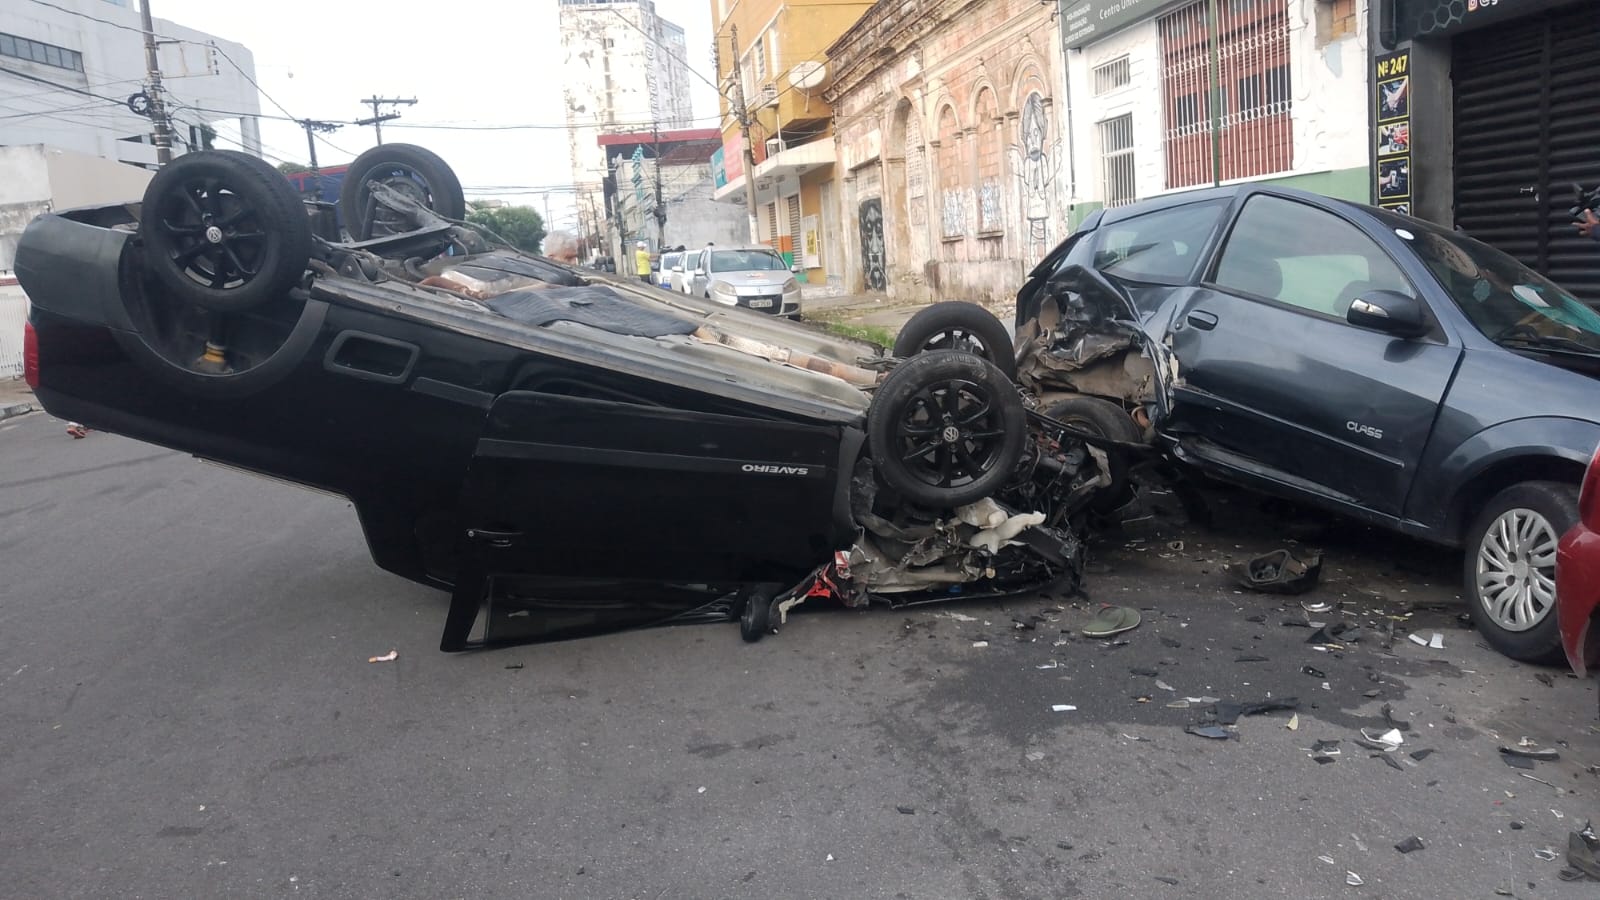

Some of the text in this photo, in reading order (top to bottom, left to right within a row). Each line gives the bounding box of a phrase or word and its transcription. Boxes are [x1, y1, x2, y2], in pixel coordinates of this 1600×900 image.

[1099, 3, 1120, 20] Centro
[1390, 55, 1408, 75] 247
[1346, 420, 1384, 439] CLASS
[741, 464, 809, 475] SAVEIRO
